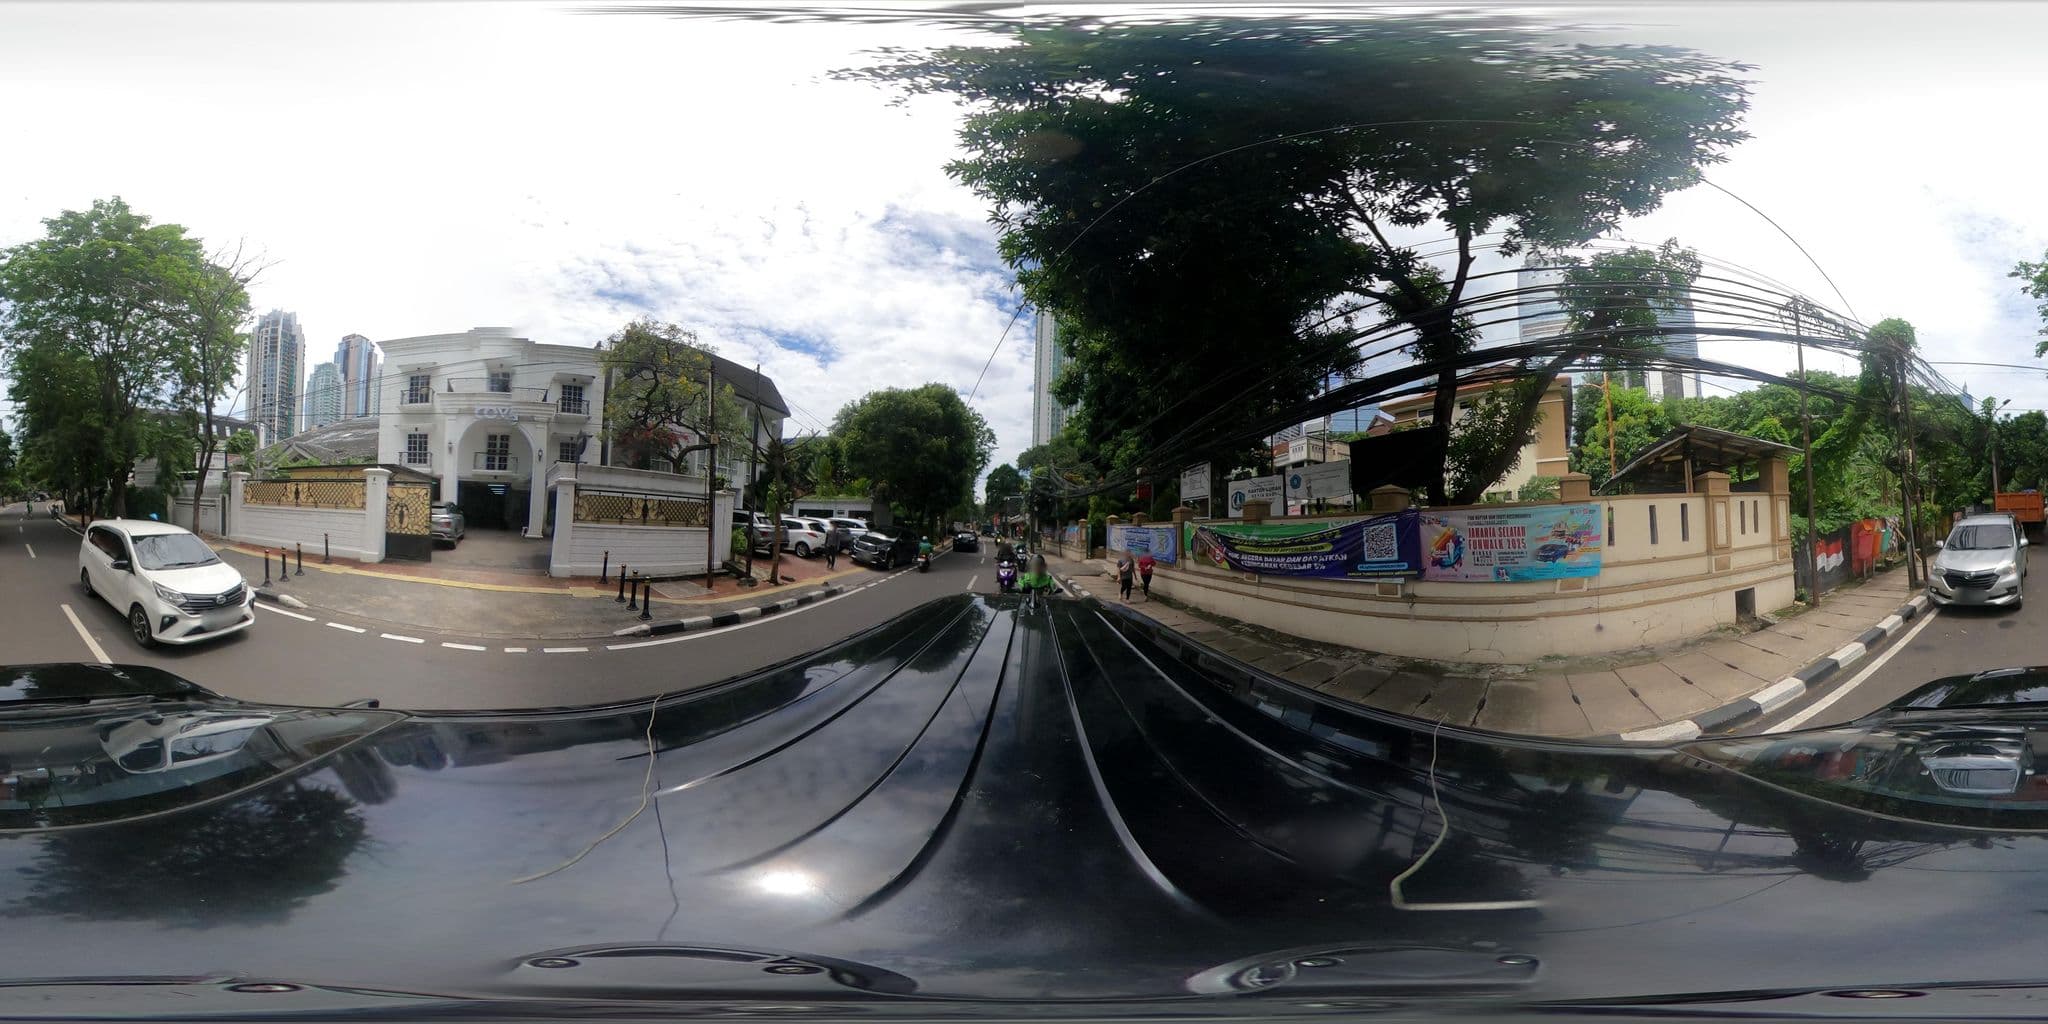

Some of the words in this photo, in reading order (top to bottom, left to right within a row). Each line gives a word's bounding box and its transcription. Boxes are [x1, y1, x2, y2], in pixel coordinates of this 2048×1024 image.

[1468, 527, 1496, 538] JAKARTA
[1498, 526, 1526, 537] SELATAN
[1468, 539, 1503, 550] FUNWALK
[1507, 538, 1527, 550] 2025
[1302, 553, 1347, 563] DAPATKAN
